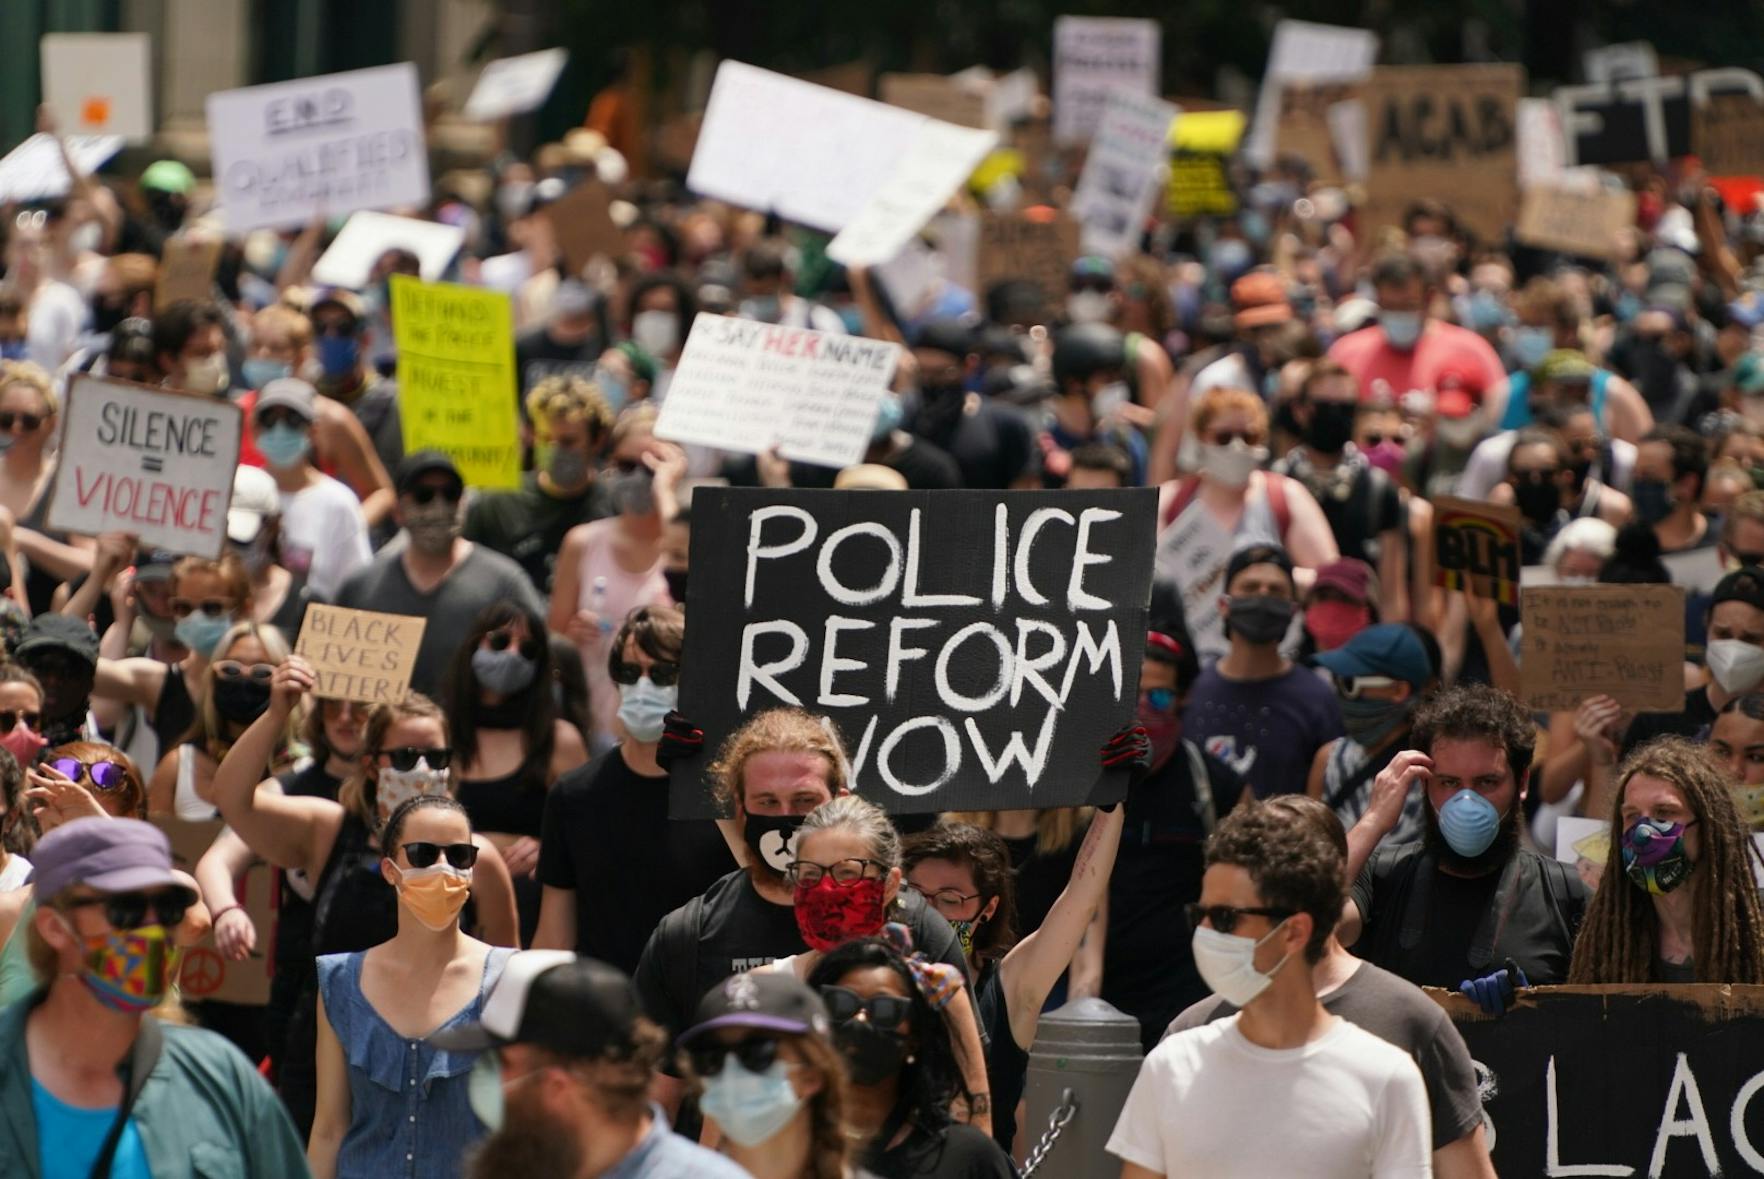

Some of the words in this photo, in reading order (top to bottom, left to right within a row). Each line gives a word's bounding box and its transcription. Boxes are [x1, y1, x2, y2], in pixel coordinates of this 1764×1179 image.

[264, 87, 355, 128] END
[1376, 93, 1515, 163] ACAB
[822, 338, 893, 370] NAME
[97, 401, 220, 458] SILENCE
[74, 465, 221, 534] VIOLENCE
[744, 503, 1124, 611] POLICE
[299, 637, 400, 671] LIVES
[311, 610, 402, 646] BLACK
[315, 669, 404, 700] ATTER!
[736, 614, 1123, 711] REFORM
[820, 706, 1060, 796] NOW
